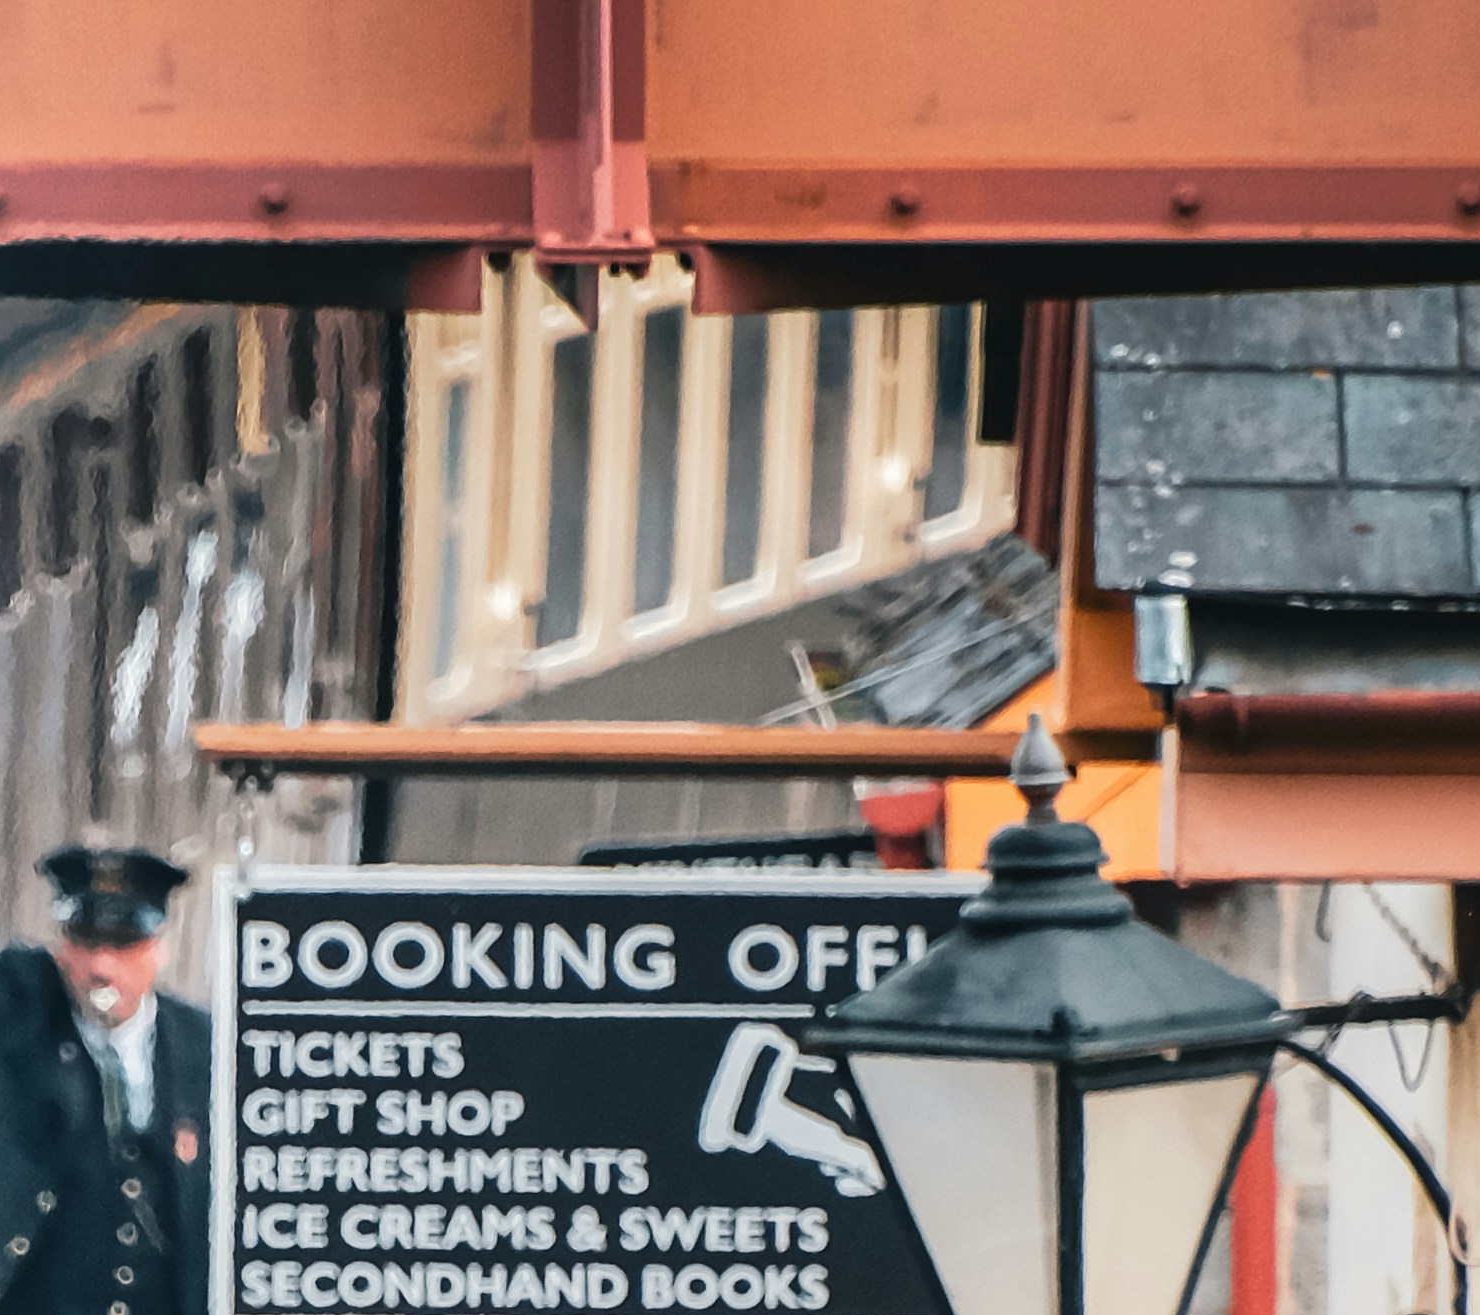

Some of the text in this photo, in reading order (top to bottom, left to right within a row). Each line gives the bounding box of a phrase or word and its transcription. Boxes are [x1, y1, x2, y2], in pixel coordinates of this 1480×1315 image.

[242, 920, 676, 992] BOOKING
[242, 1029, 465, 1079] TICKETS
[242, 1087, 525, 1137] GIFT SHOP
[242, 1145, 650, 1195] REFRESHMENTS
[242, 1203, 830, 1254] ICE CREAMS & SWEETS
[241, 1260, 830, 1311] SECONDHAND BOOKS
